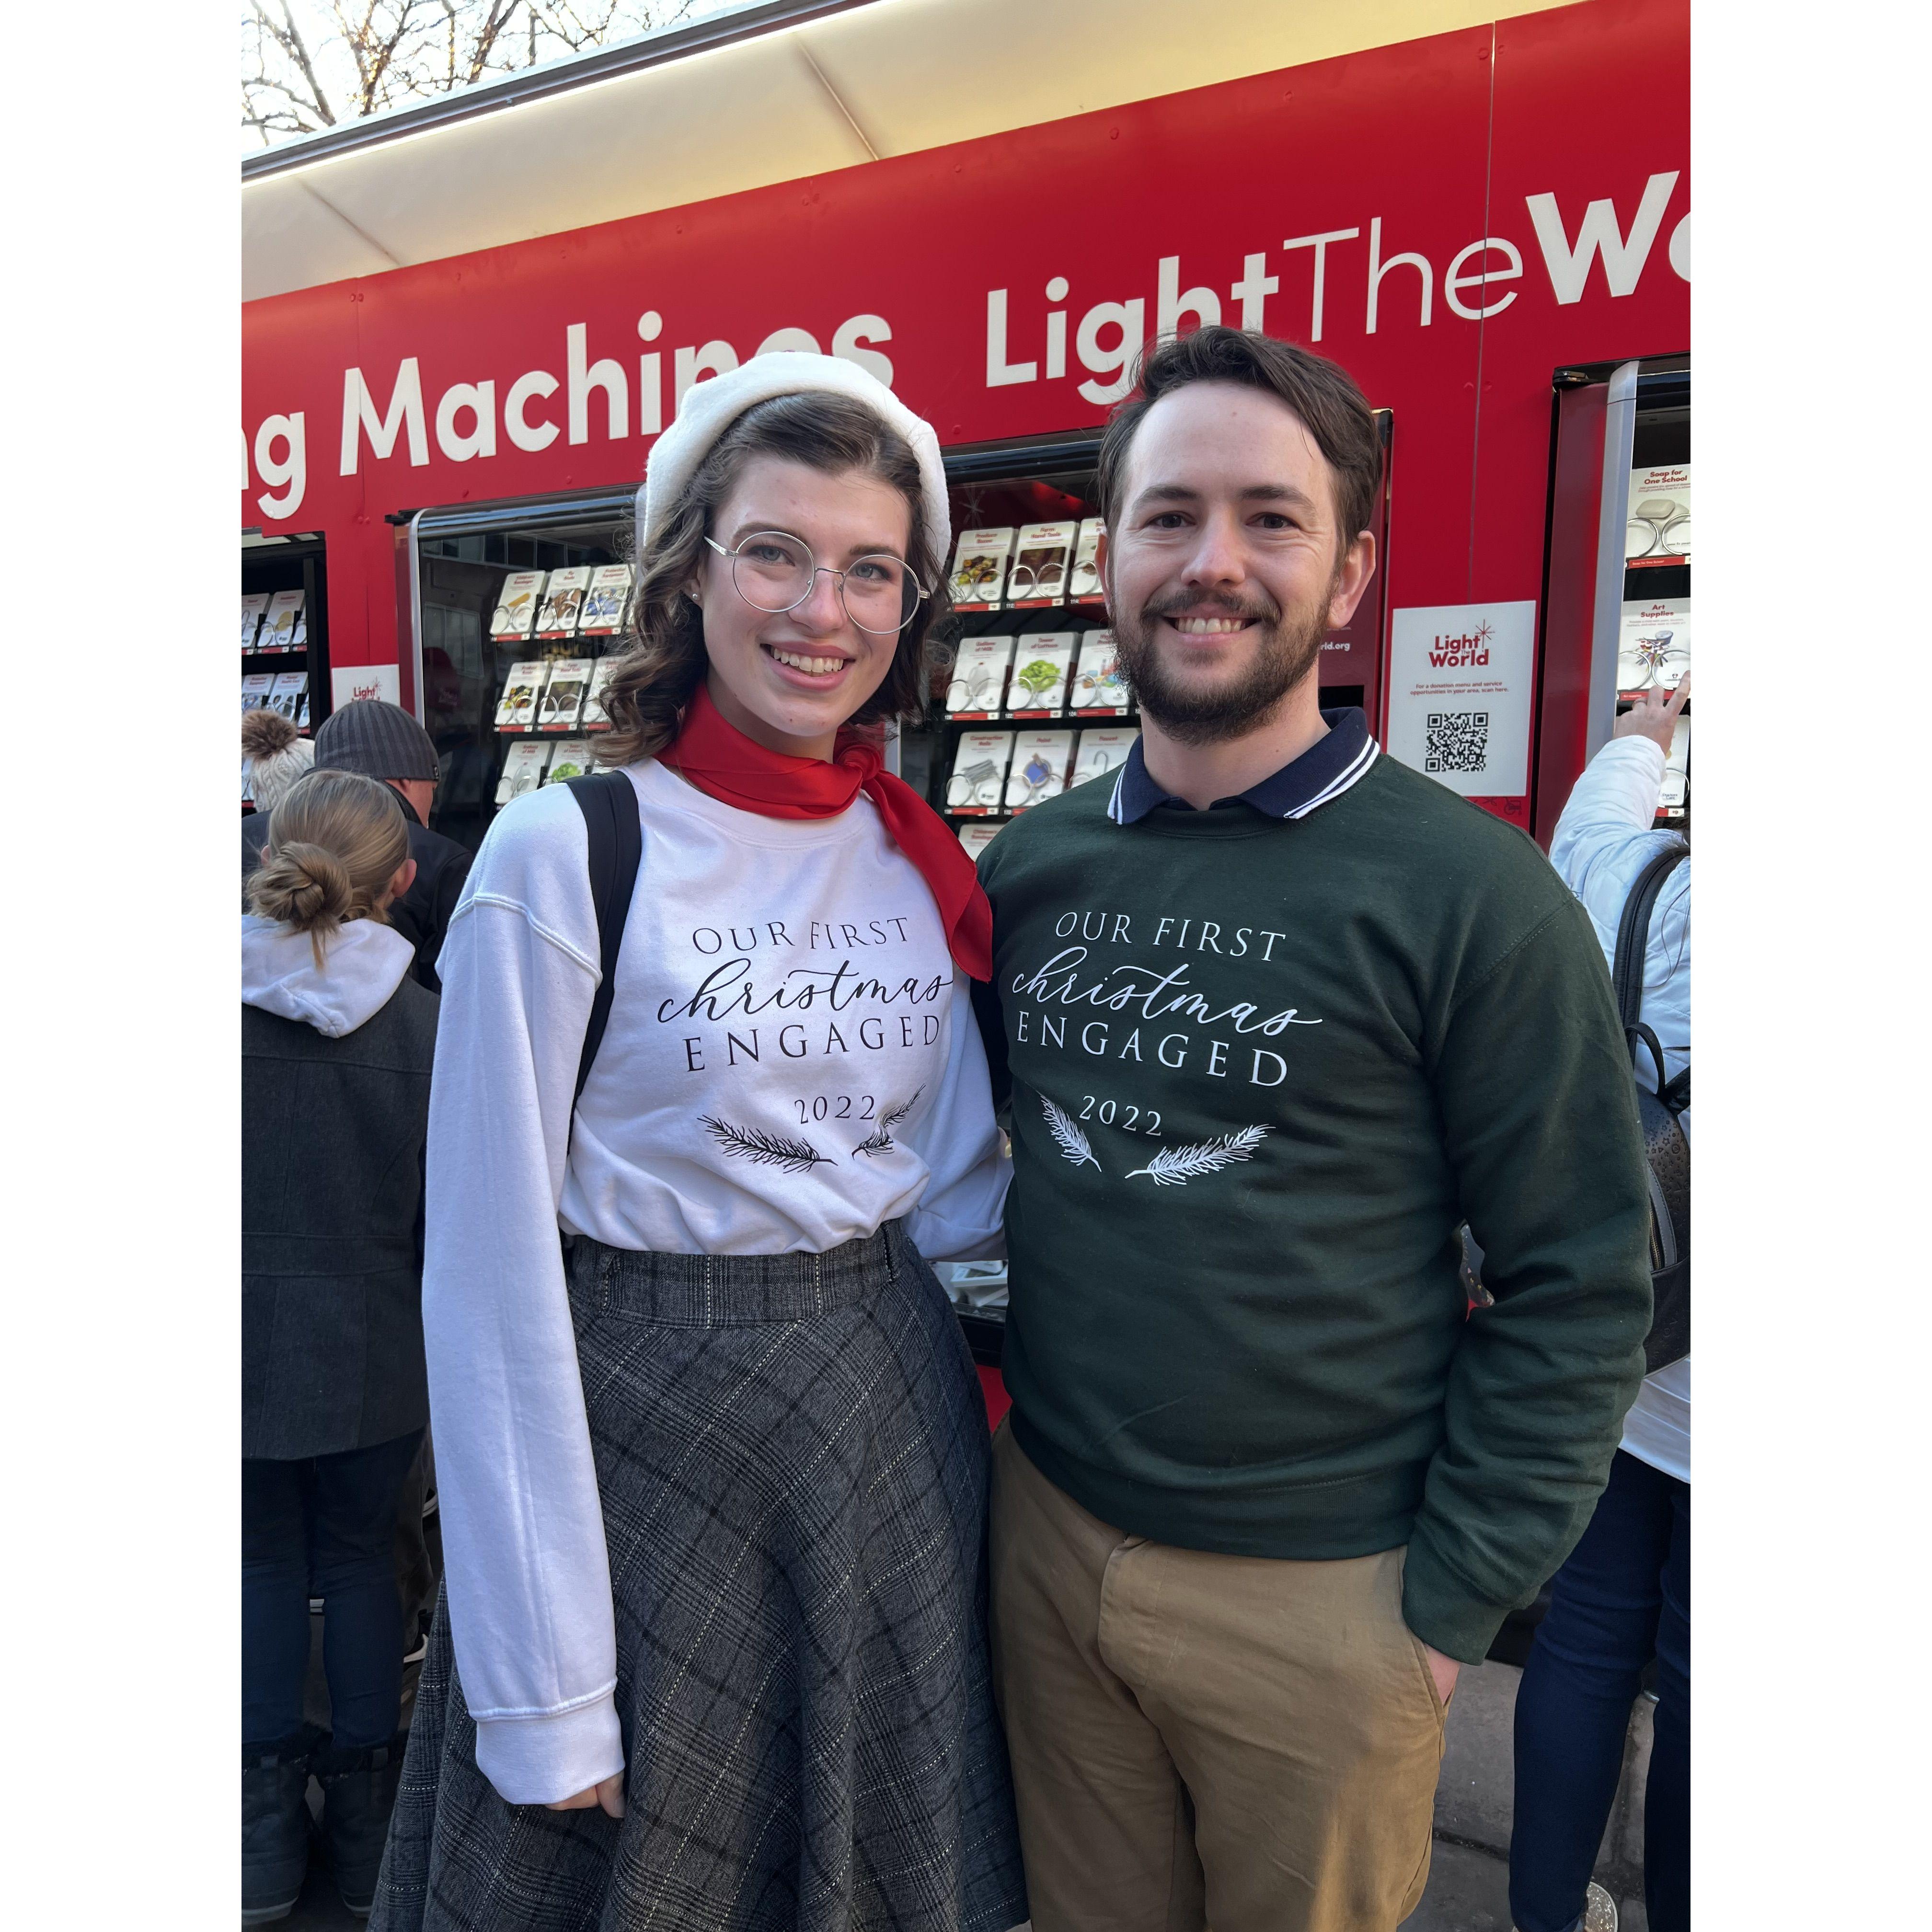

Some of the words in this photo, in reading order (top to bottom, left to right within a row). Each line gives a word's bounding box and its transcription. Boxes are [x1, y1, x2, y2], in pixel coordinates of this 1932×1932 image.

[340, 310, 894, 477] Machins
[1428, 649, 1489, 667] World
[1435, 634, 1481, 654] Light
[354, 686, 376, 701] Light
[692, 921, 795, 954] OUR
[810, 917, 908, 950] FIRST
[1055, 911, 1132, 943] OUR
[1152, 917, 1286, 962] FIRST
[657, 957, 954, 1023] christmas
[1012, 946, 1322, 1036] christmas
[682, 1015, 940, 1072] ENGAGED
[1017, 1011, 1288, 1087] ENGAGED
[794, 1095, 875, 1125] 2022
[1079, 1095, 1162, 1137] 2022
